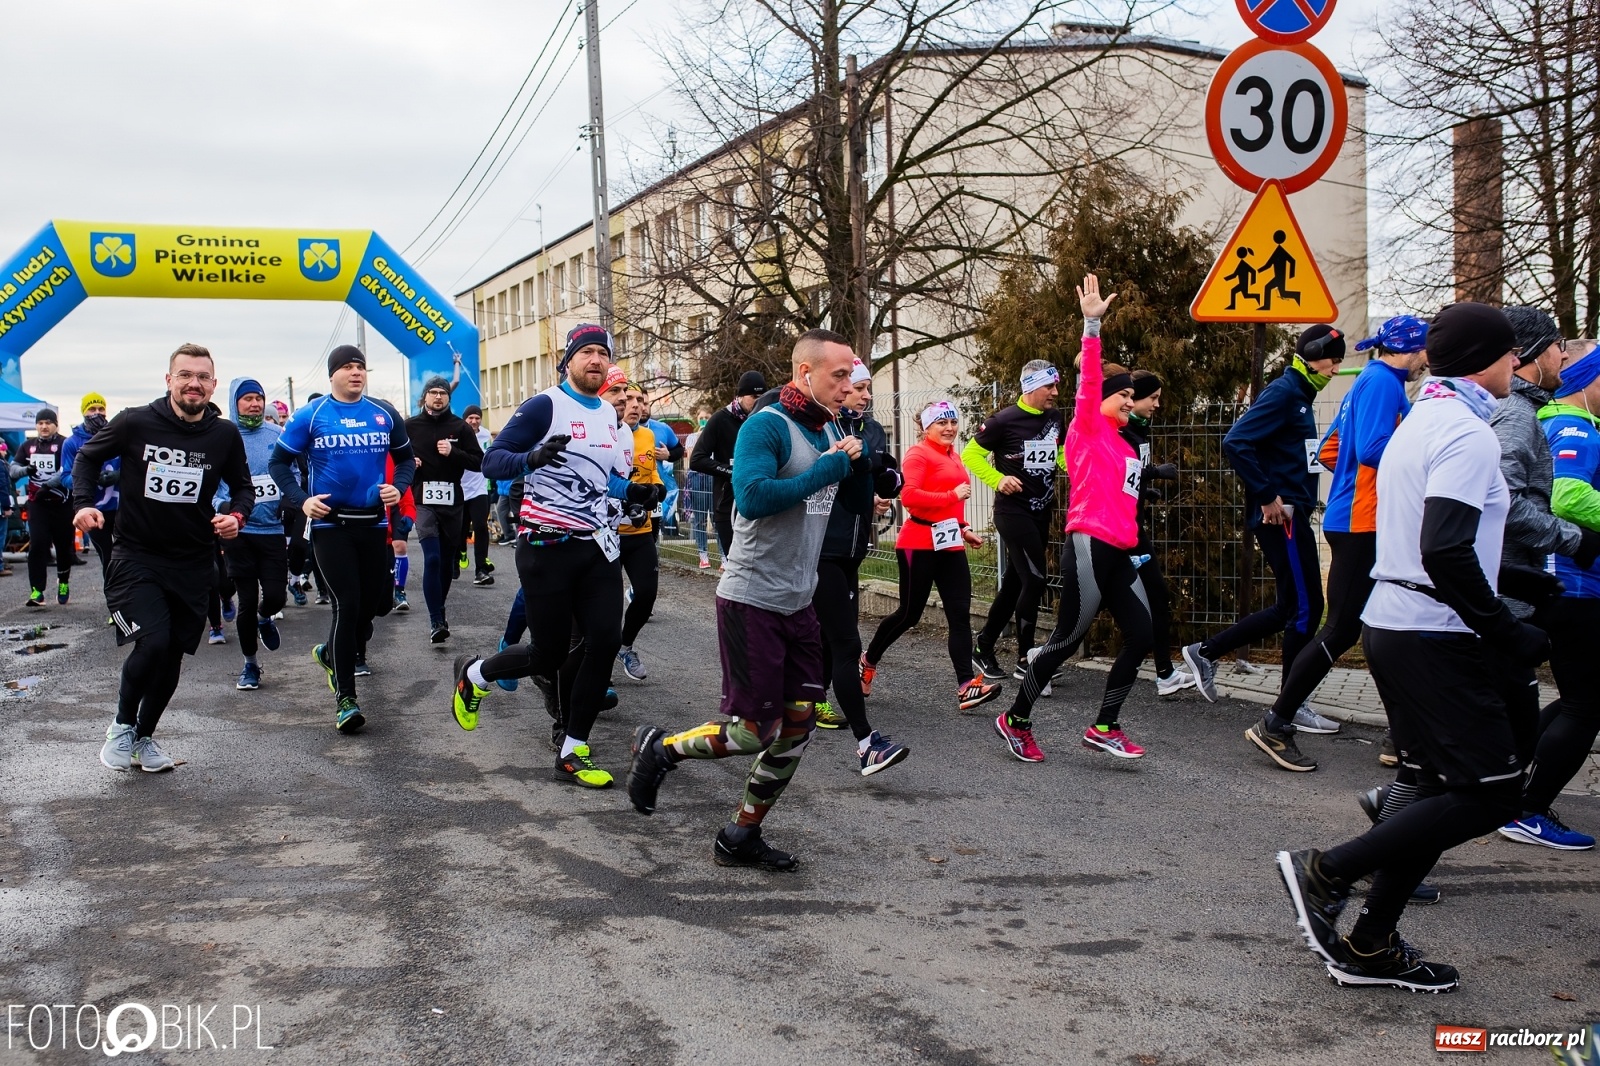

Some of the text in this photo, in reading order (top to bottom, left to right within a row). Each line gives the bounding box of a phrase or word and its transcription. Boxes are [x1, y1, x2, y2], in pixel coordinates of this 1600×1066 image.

[1230, 75, 1325, 155] 30
[176, 234, 260, 248] Gmina
[12, 245, 56, 285] ludzi
[154, 249, 283, 267] Pietrowice
[171, 268, 267, 284] Wielkie
[372, 256, 453, 333] Gmina ludzi
[359, 274, 436, 346] aktywnych
[142, 443, 187, 468] FOB
[1026, 450, 1056, 464] 424
[188, 462, 212, 470] BOARD
[148, 476, 198, 498] 362
[425, 489, 451, 501] 331
[935, 528, 958, 545] 27
